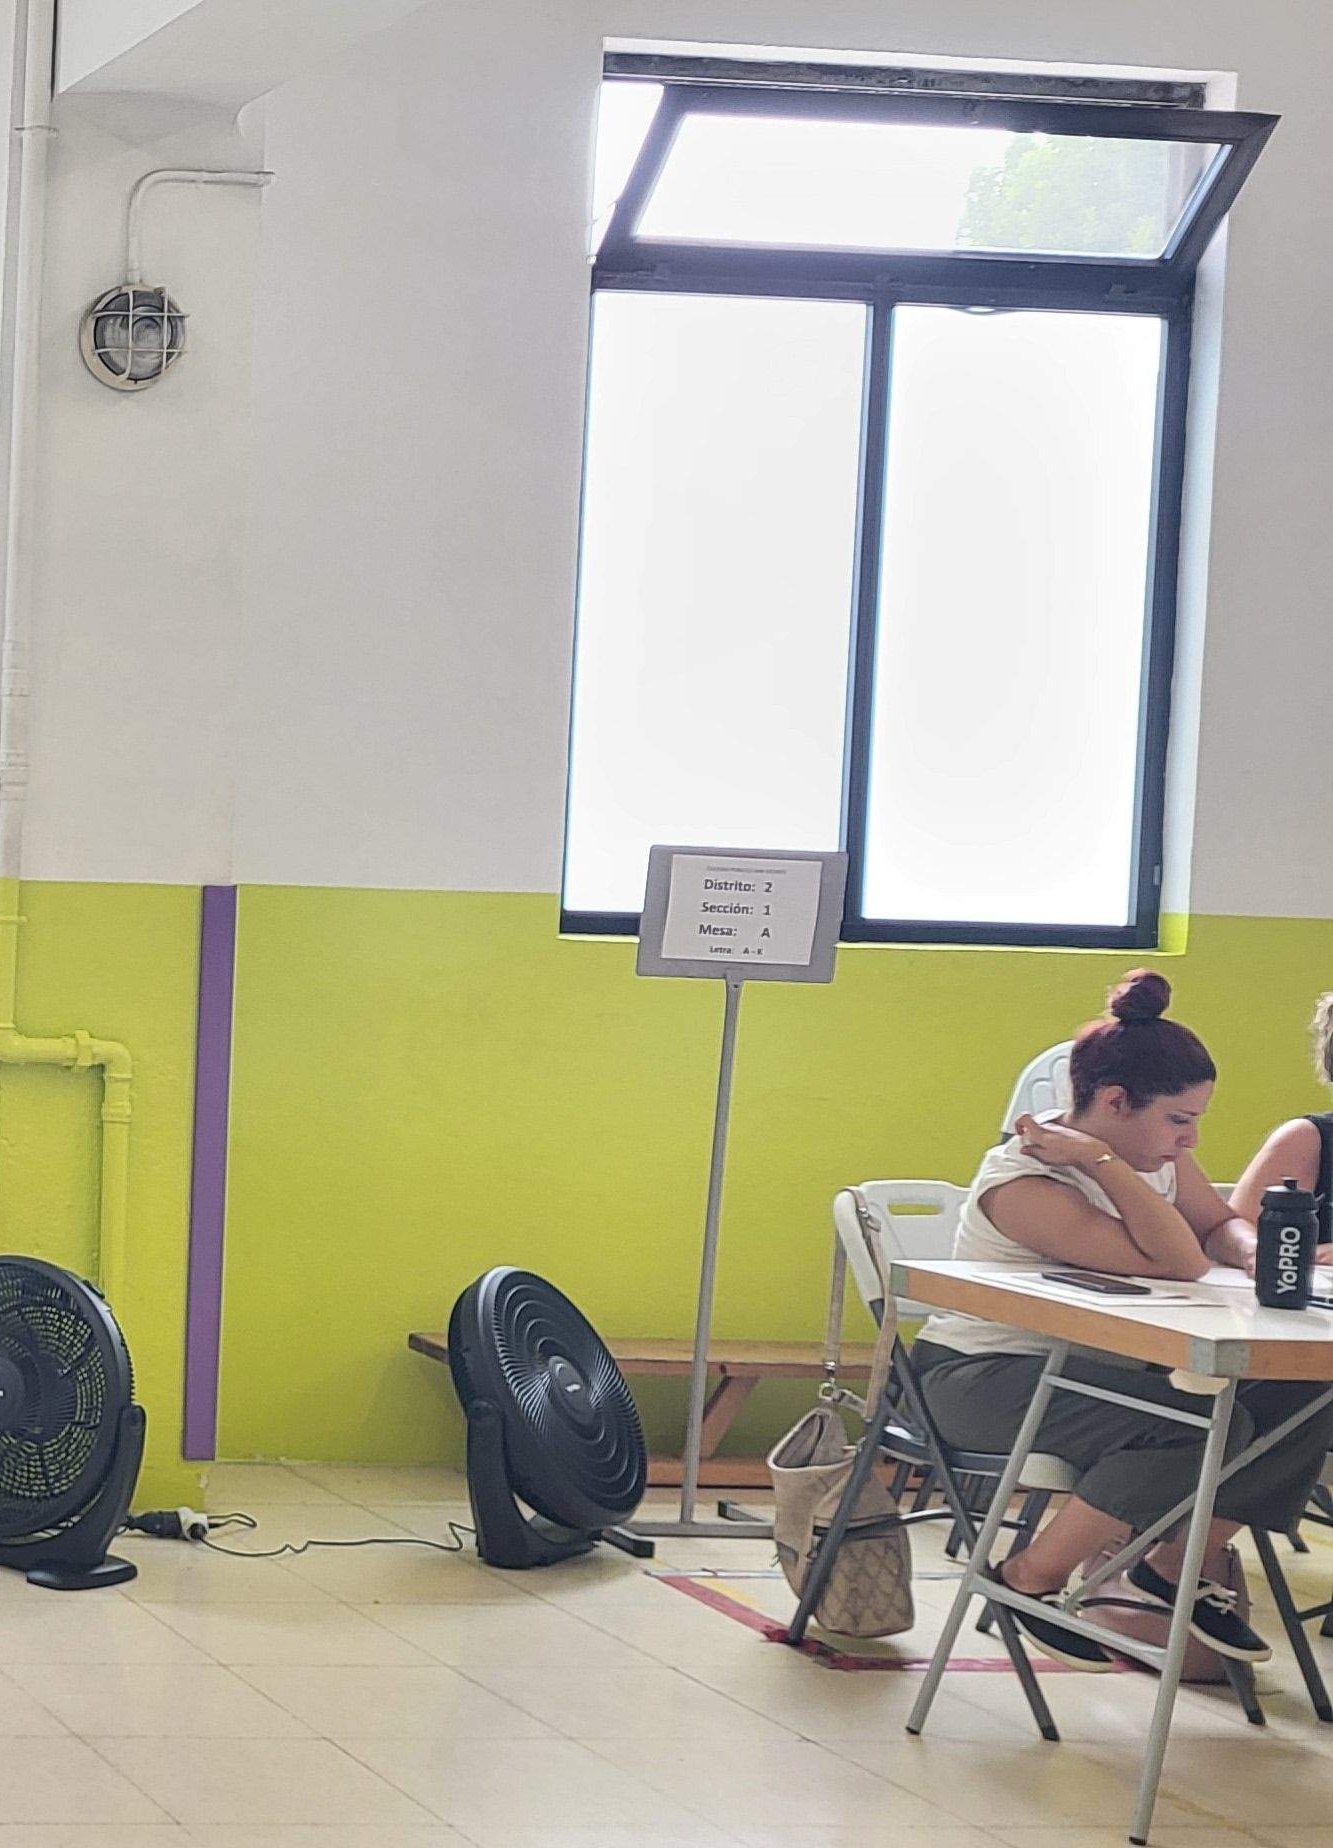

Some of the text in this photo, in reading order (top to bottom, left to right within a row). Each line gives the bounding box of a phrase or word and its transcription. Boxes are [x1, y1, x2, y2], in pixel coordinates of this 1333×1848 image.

[703, 878, 773, 893] Distrito: 2
[700, 901, 771, 916] Sección: 1
[698, 923, 771, 938] Mesa: A
[1276, 1226, 1301, 1295] YoPRO
